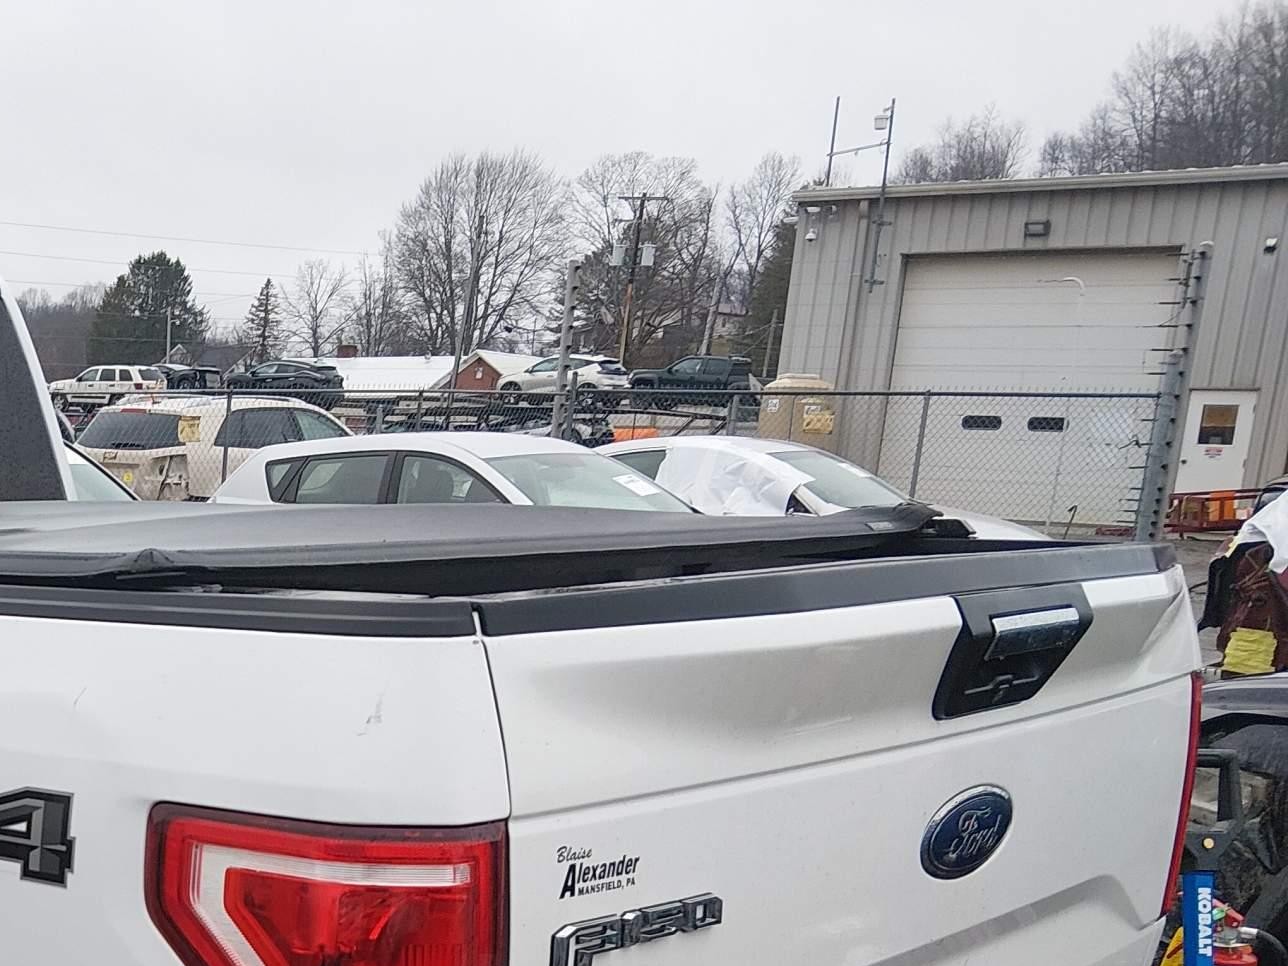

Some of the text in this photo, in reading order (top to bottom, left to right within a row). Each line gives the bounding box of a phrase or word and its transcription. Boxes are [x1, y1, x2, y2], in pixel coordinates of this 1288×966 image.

[556, 845, 592, 863] Blaise
[559, 854, 640, 899] Alexander
[578, 877, 635, 896] MANSFIELD, PA
[1197, 887, 1212, 957] KOBALT
